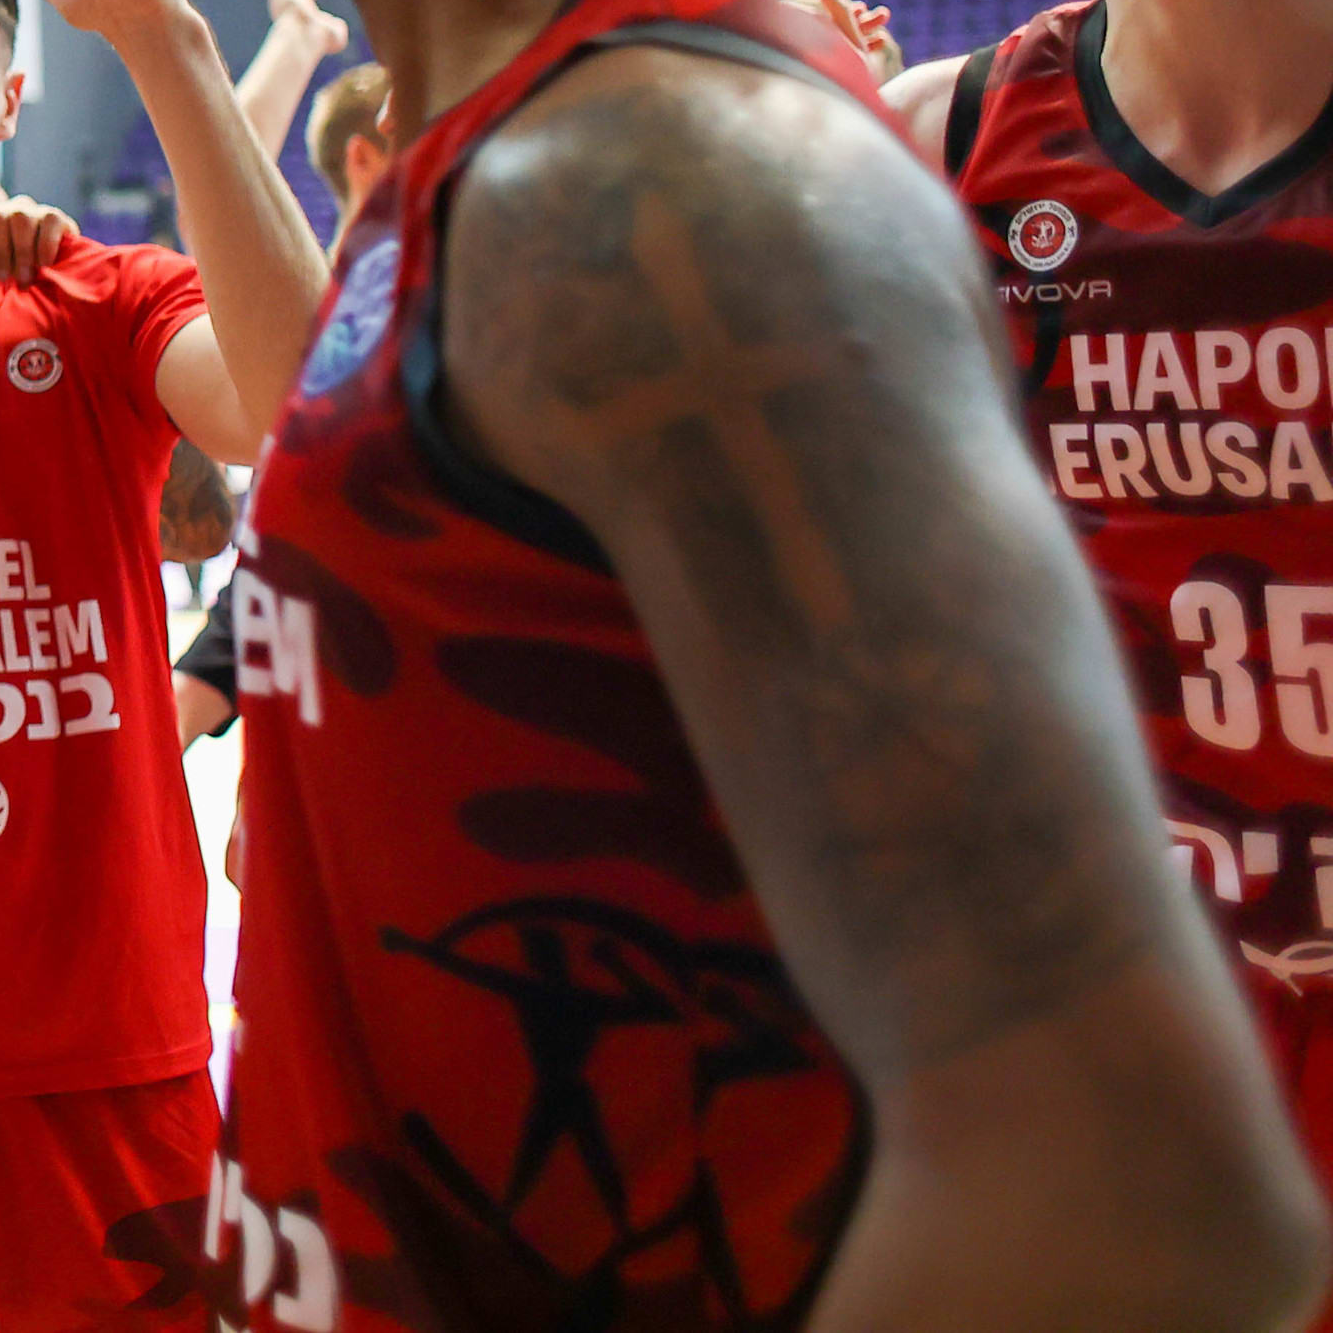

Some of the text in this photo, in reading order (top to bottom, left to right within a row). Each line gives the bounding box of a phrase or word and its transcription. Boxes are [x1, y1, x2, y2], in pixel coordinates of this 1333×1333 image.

[998, 280, 1112, 304] IVOVA
[1070, 326, 1333, 412] HAPO
[1049, 421, 1333, 503] ERUSA
[1170, 580, 1333, 758] 35
